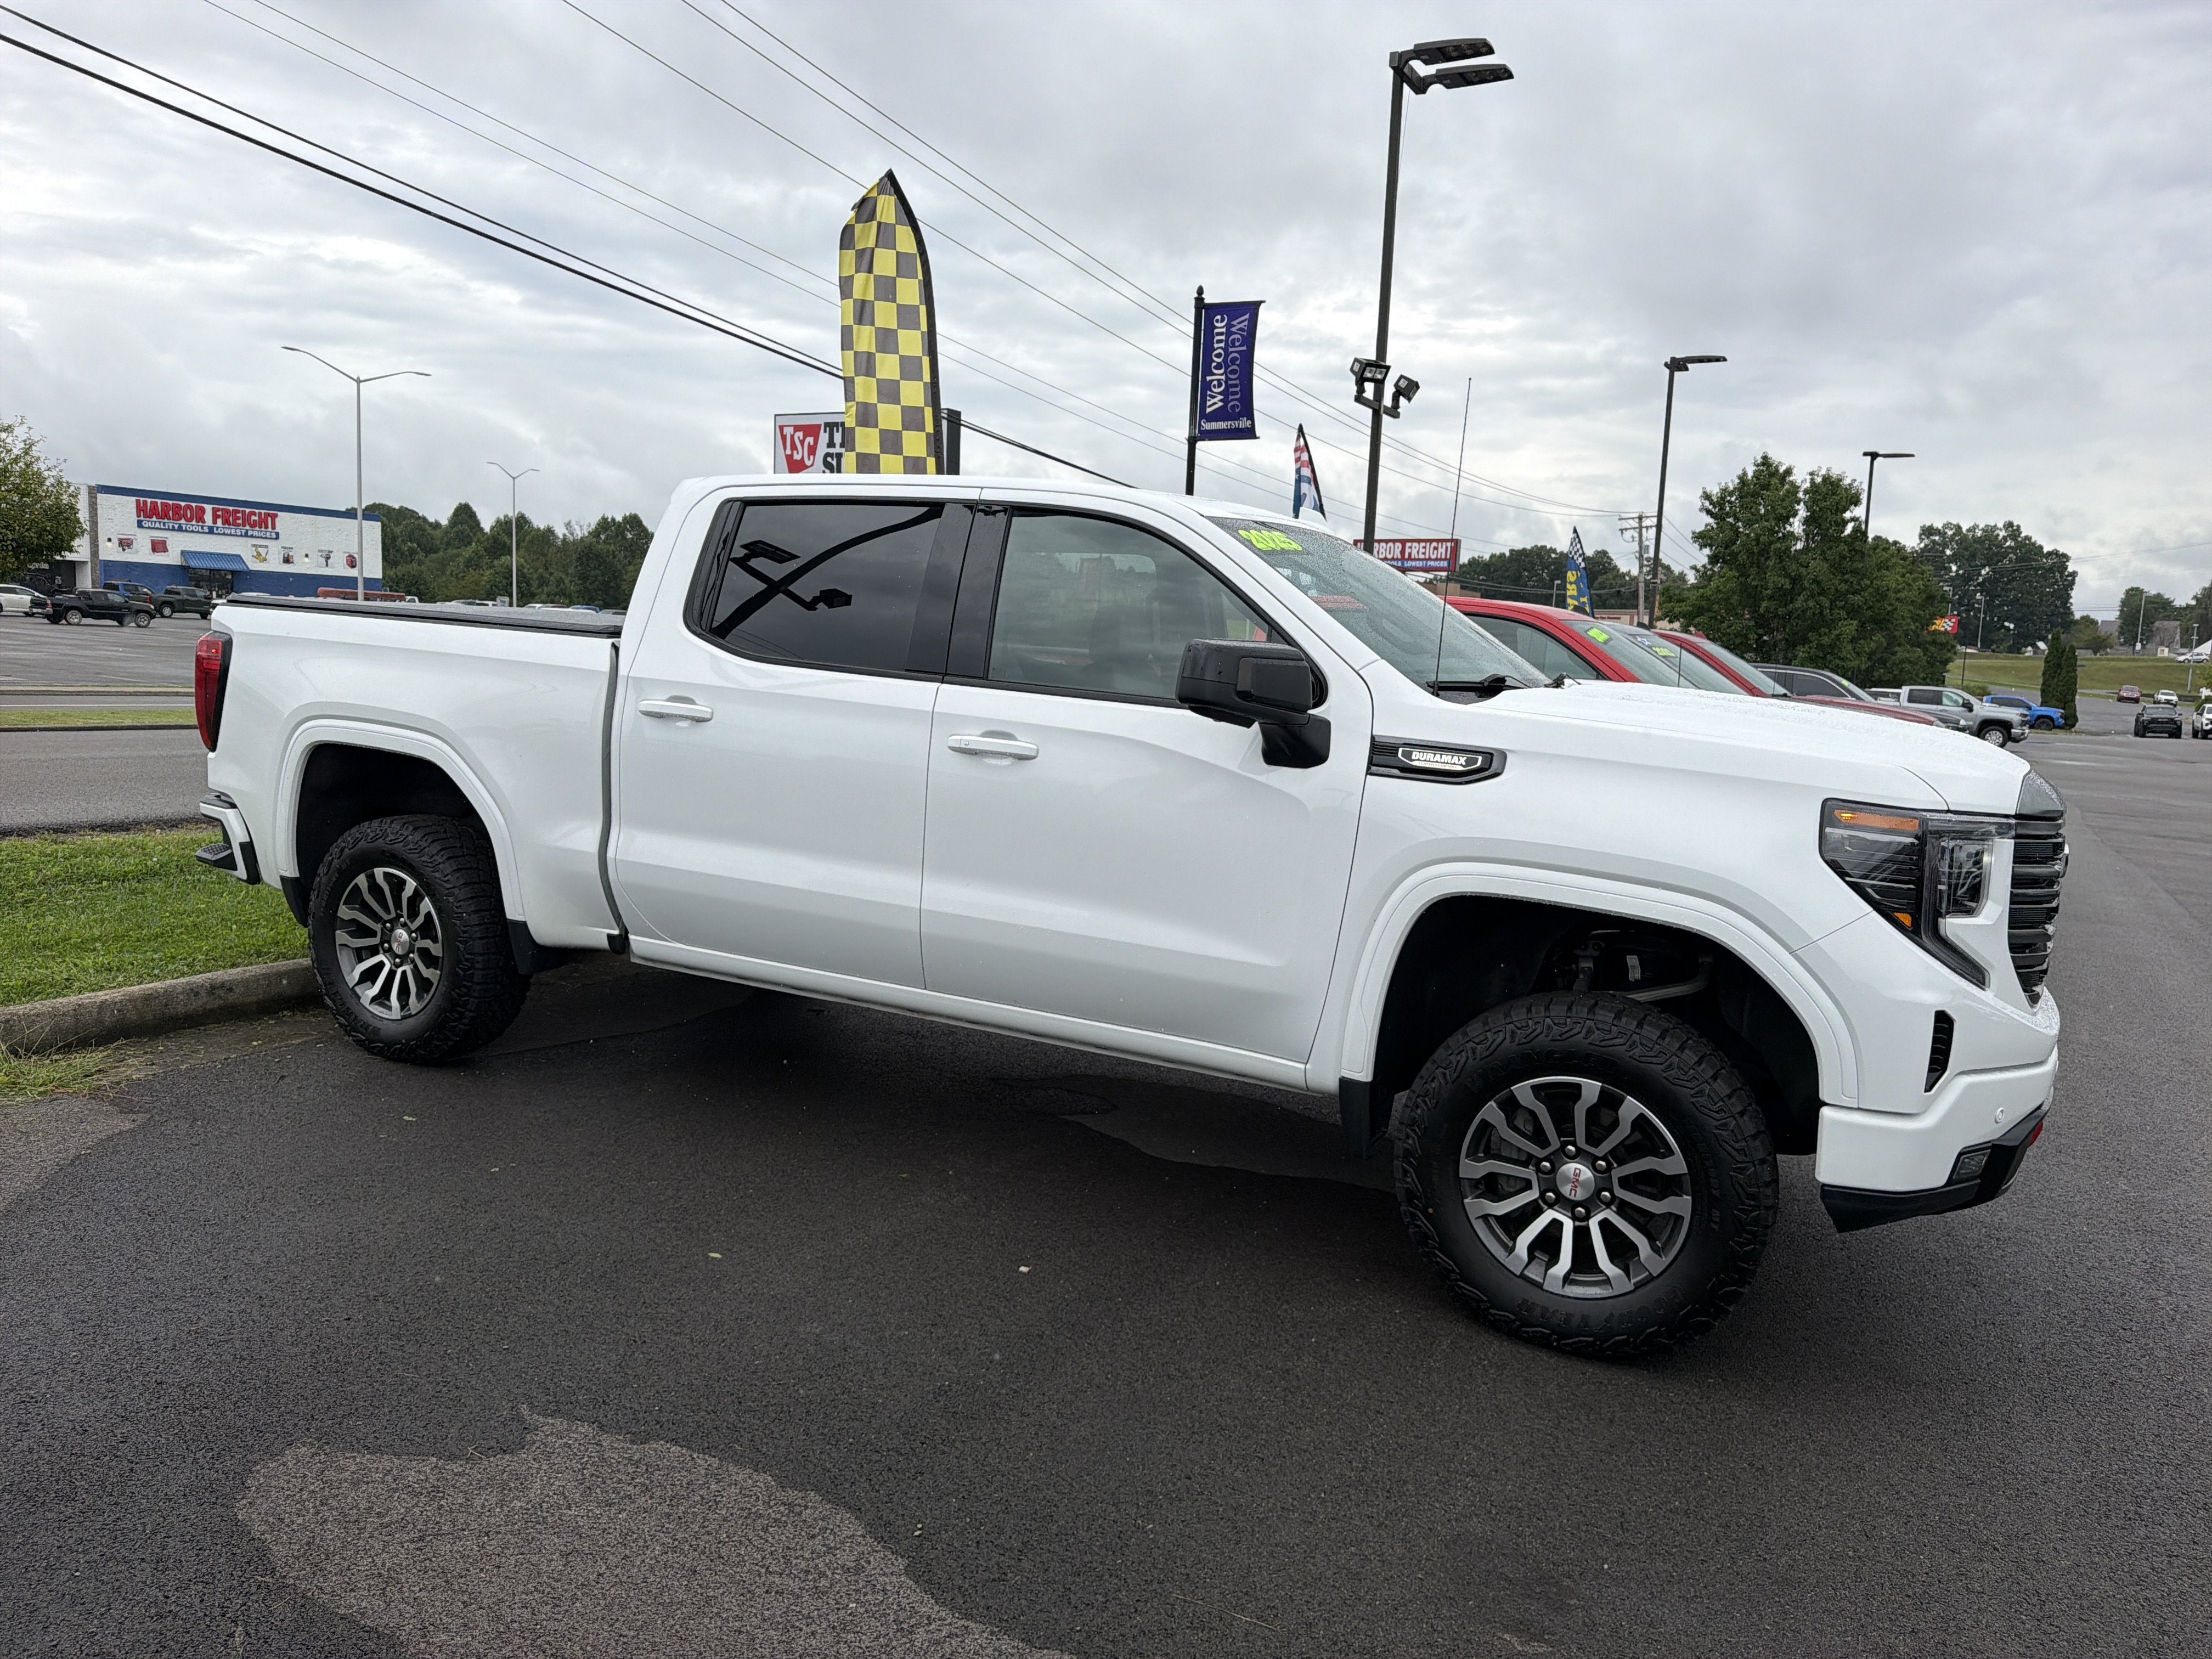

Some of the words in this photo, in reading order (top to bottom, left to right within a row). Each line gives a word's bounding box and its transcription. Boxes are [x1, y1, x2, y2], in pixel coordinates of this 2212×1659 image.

[1206, 314, 1228, 414] Welcome
[1227, 313, 1250, 413] Welcome
[1200, 417, 1252, 430] Summersville
[783, 426, 814, 466] TSC
[136, 499, 206, 523] HARBOR
[212, 506, 278, 530] FREIGHT
[142, 521, 179, 530] QUALITY
[181, 524, 208, 533] TOOLS
[214, 527, 246, 535] LOWEST
[1238, 529, 1302, 551] 2025
[1357, 542, 1402, 558] RBOR
[1405, 542, 1453, 558] FREIGHT
[1412, 751, 1467, 765] DURAMAX
[1568, 1167, 1582, 1198] GMC
